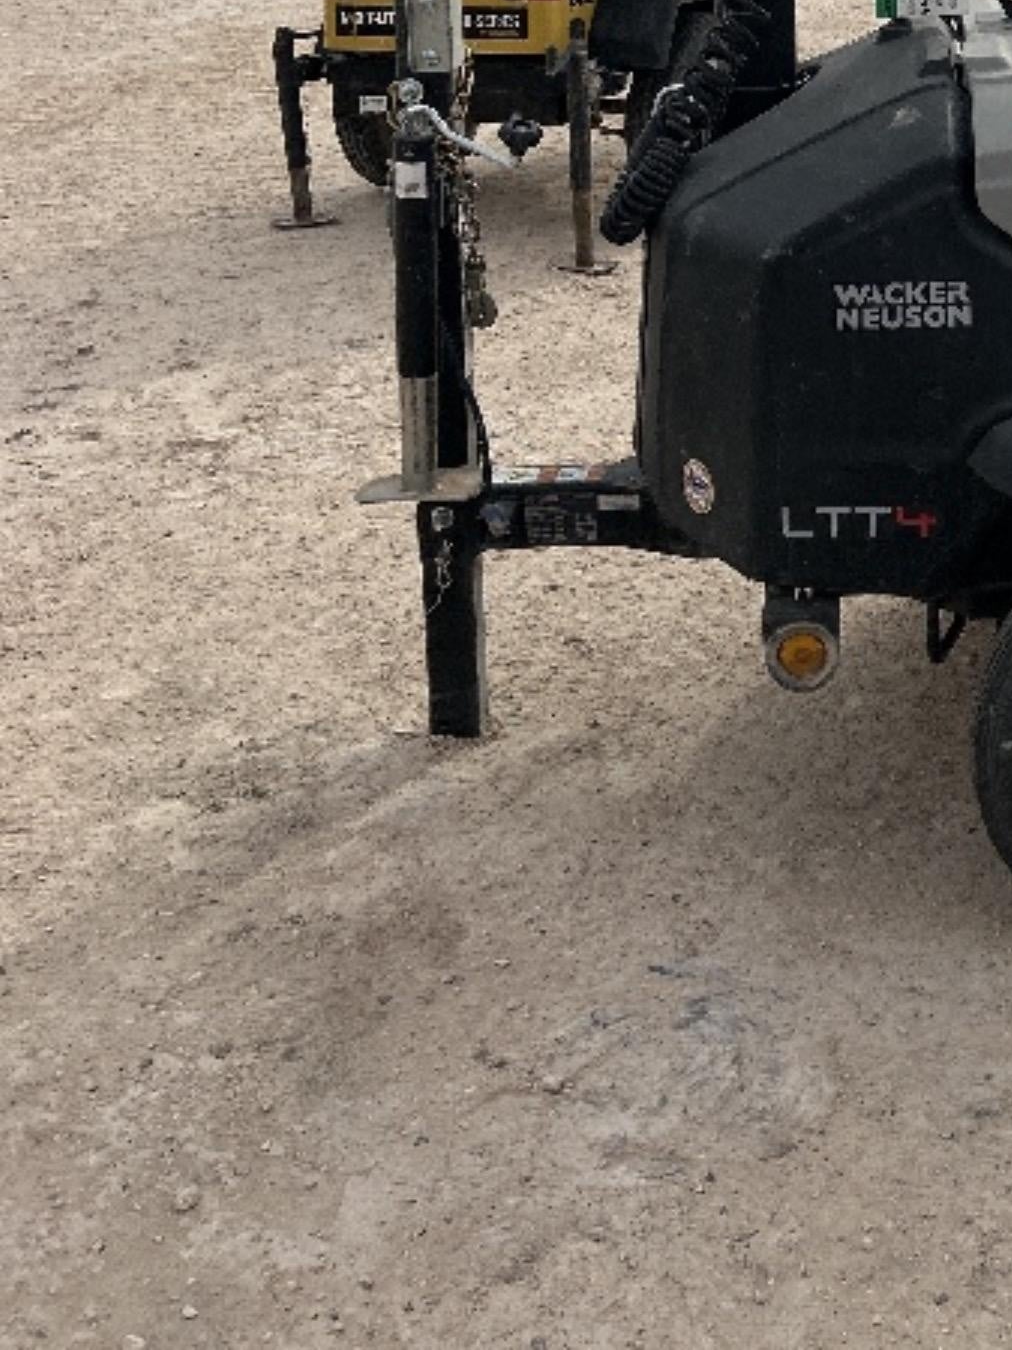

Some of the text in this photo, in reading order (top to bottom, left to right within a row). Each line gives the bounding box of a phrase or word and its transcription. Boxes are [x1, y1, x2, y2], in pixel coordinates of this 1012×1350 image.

[833, 281, 972, 306] WACKER
[836, 305, 973, 331] NEUSON
[781, 506, 936, 538] LTT4
